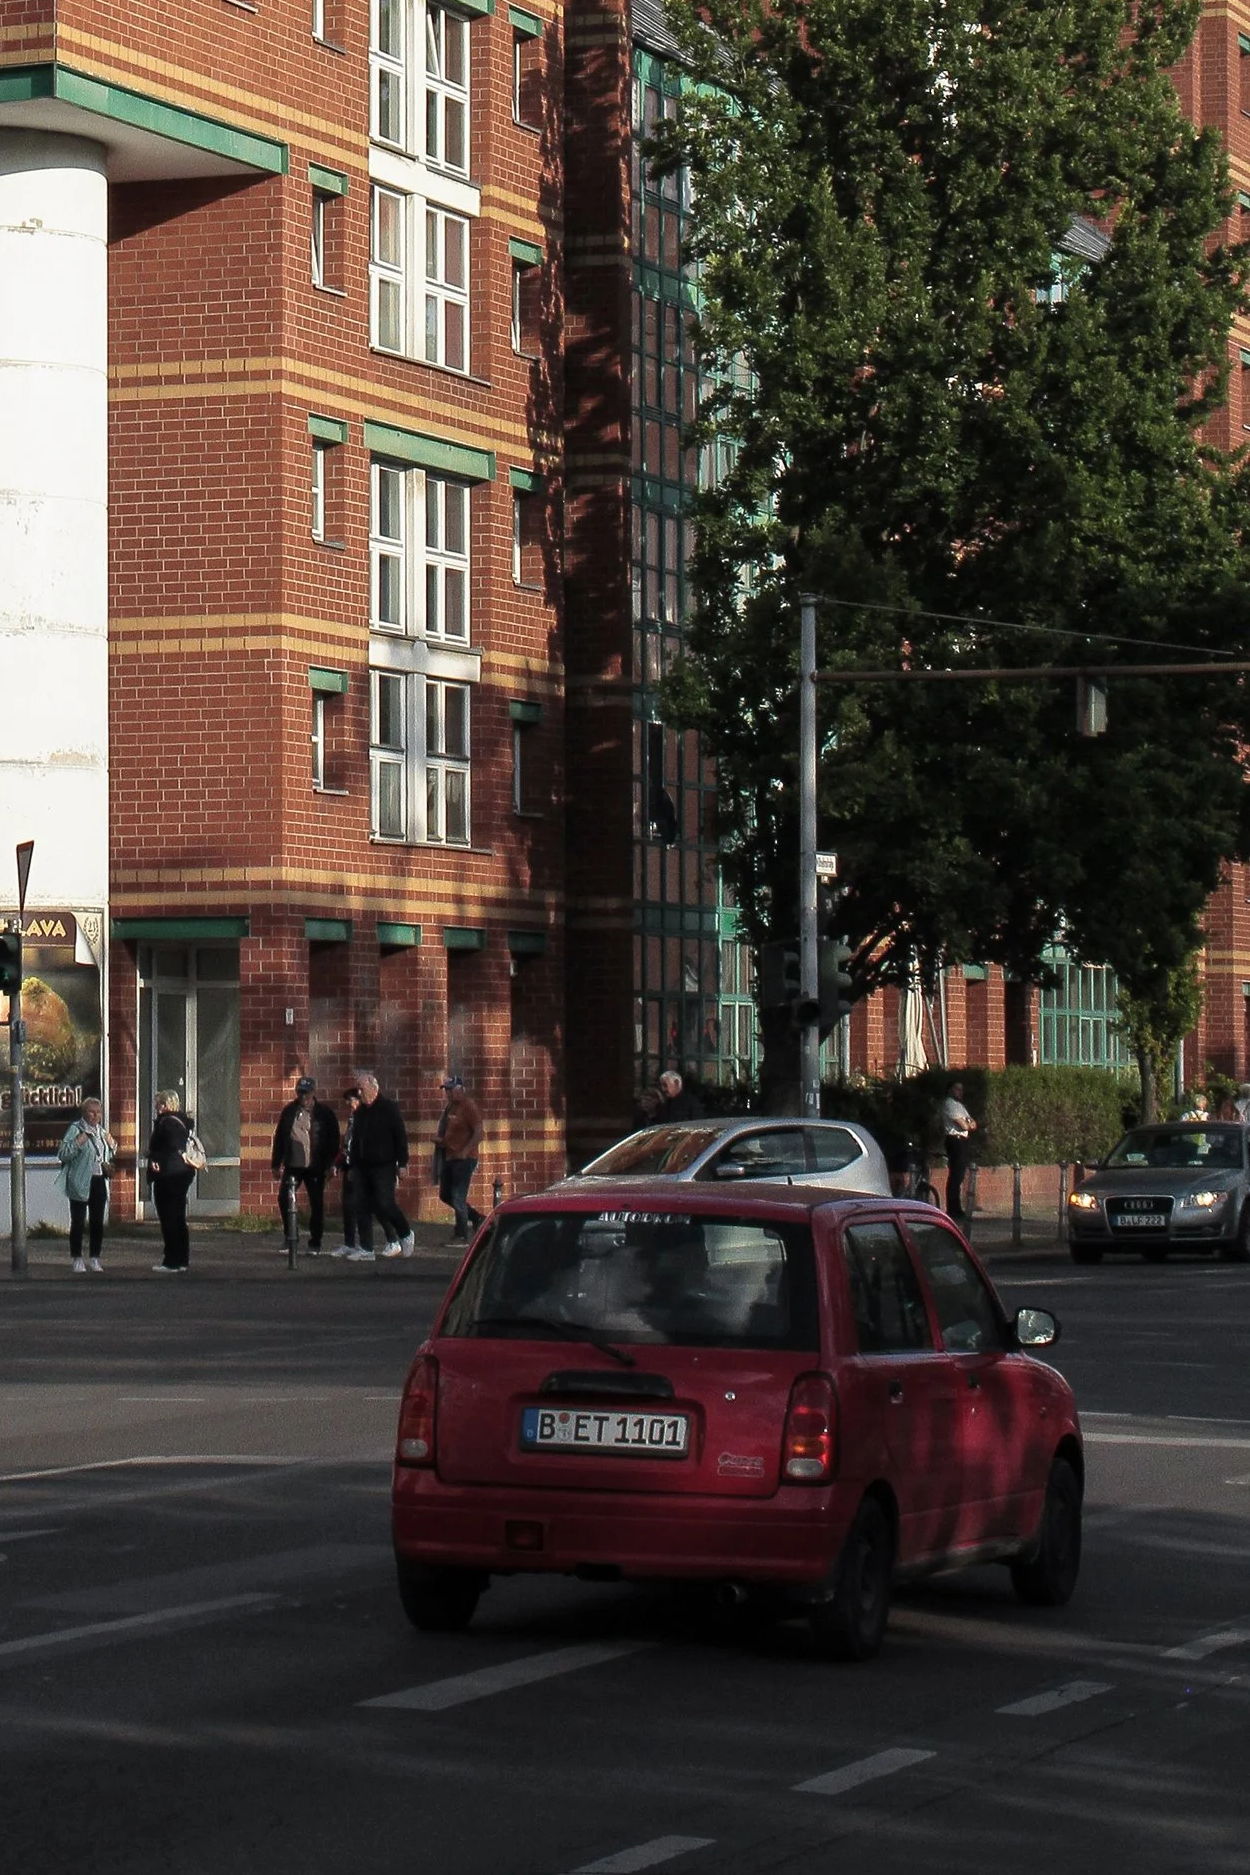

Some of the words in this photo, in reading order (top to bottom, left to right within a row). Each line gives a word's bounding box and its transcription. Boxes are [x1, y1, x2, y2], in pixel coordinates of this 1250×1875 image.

[0, 1085, 83, 1111] gücklich!
[538, 1412, 556, 1440] B
[574, 1414, 610, 1443] ET
[613, 1416, 681, 1446] 1101
